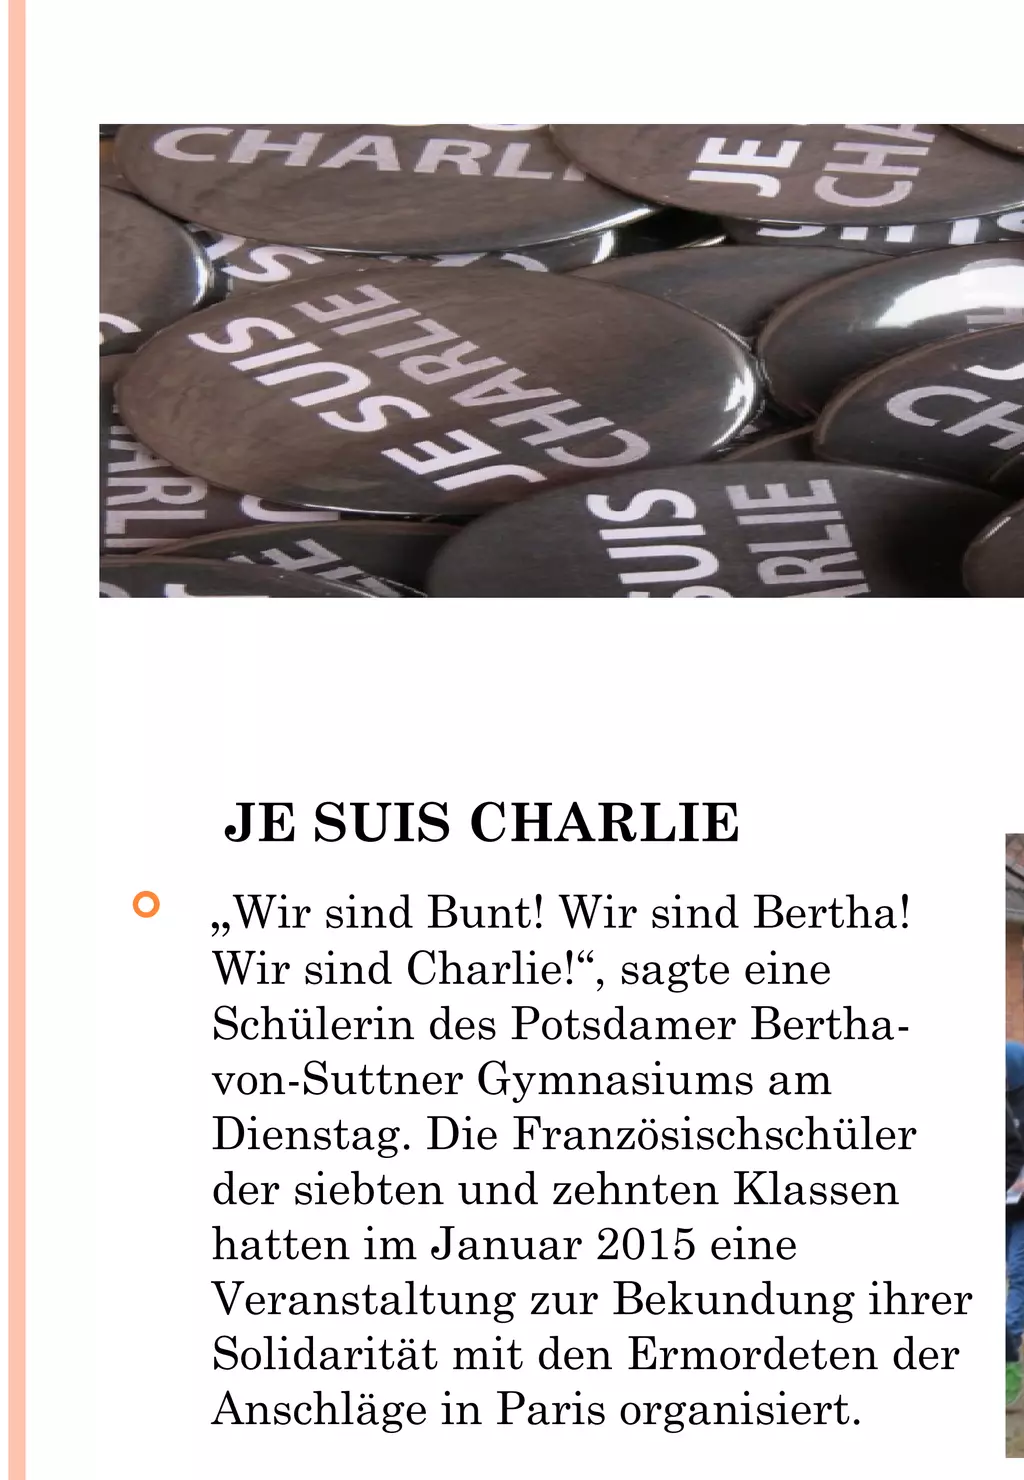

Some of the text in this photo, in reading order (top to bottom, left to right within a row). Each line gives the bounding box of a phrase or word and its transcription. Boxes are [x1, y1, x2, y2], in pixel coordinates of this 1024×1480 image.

[188, 317, 432, 432] SUIS
[291, 284, 650, 467] CHARLIE
[225, 802, 738, 842] JE SUIS CHARLIE
[212, 894, 908, 937] „Wir sind Bunt! Wir sind Bertha!
[212, 950, 830, 993] Wir sind Charlie!“, sagte eine
[214, 1006, 908, 1040] Schülerin des Potsdamer Bertha-
[212, 1060, 831, 1103] von-Suttner Gymnasiums am
[213, 1116, 916, 1158] Dienstag. Die Französischschüler
[214, 1171, 899, 1205] der siebten und zehnten Klassen
[212, 1226, 796, 1260] hatten im Januar 2015 eine
[211, 1281, 972, 1323] Veranstaltung zur Bekundung ihrer
[214, 1335, 959, 1370] Solidarität mit den Ermordeten der
[211, 1390, 859, 1433] Anschläge in Paris organisiert.
